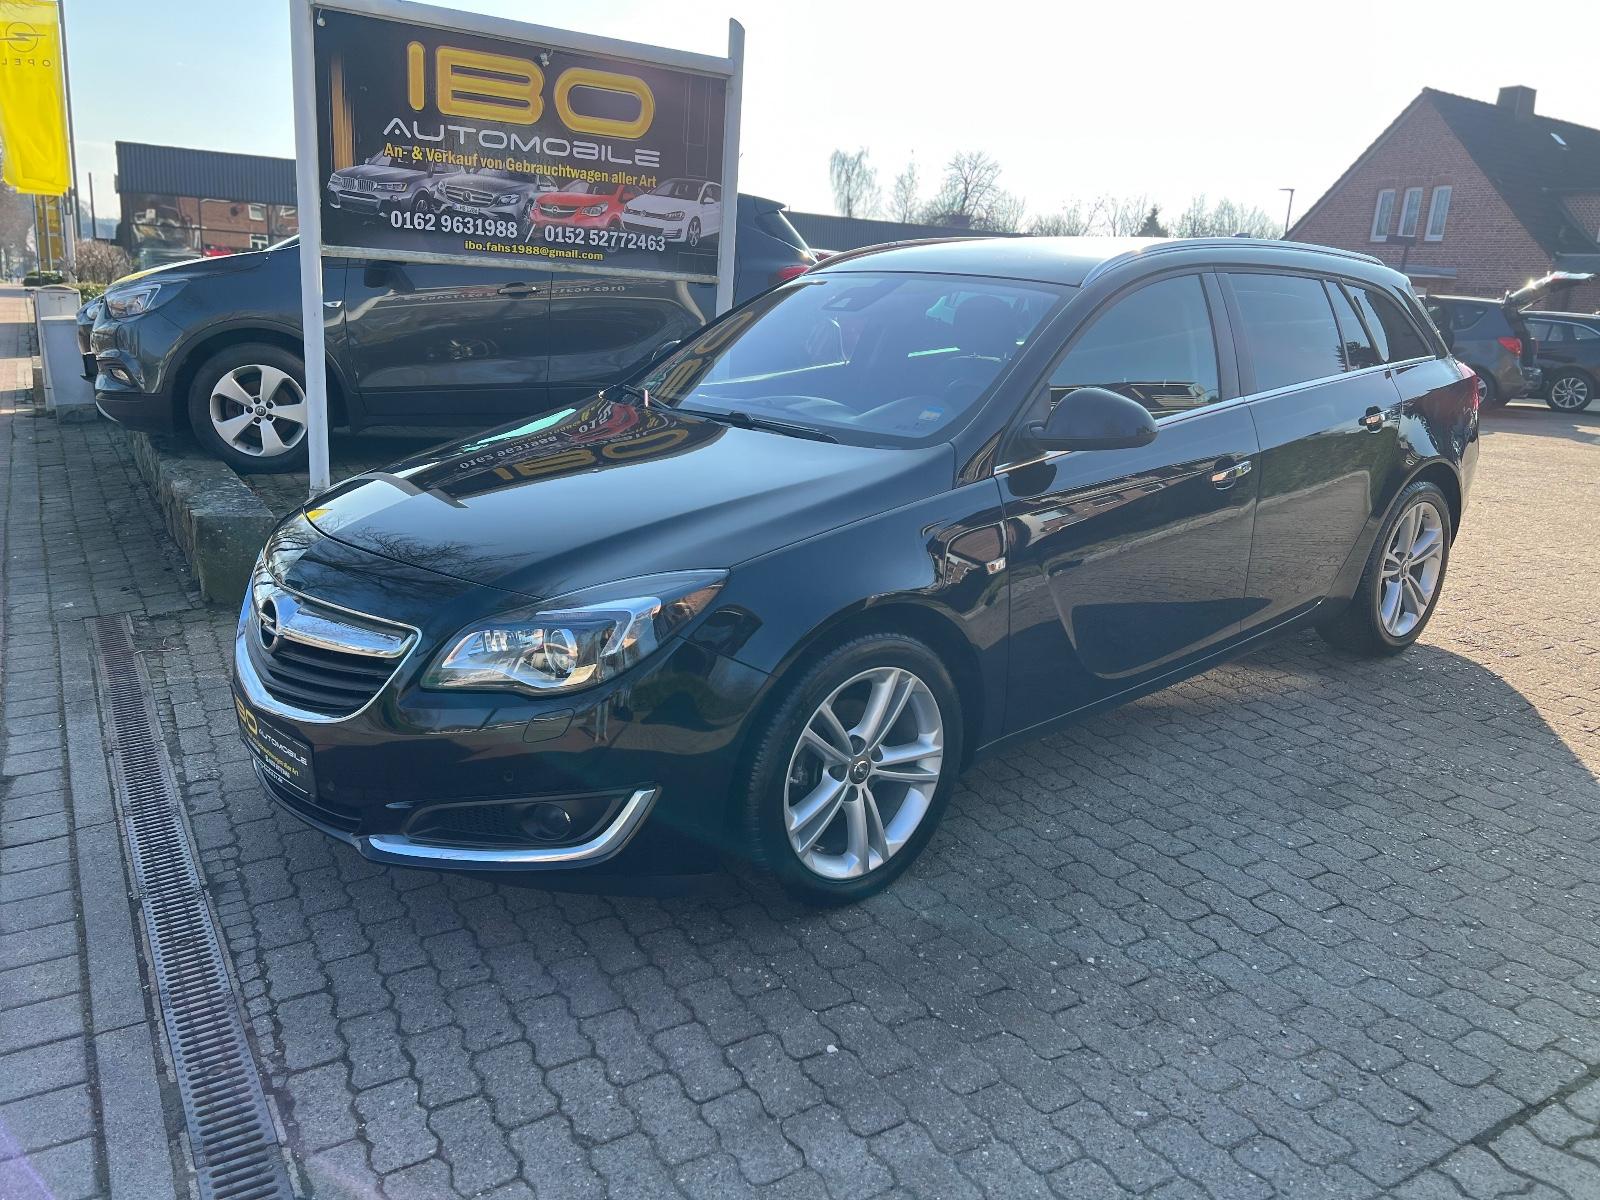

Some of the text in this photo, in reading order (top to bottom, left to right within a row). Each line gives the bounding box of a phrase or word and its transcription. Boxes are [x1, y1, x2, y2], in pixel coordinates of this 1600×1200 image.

[406, 40, 656, 140] IBO
[383, 117, 661, 168] AUTOMOBILE
[384, 142, 657, 188] An- & Verkauf von Gebrauchtwagen aller Art
[390, 210, 436, 231] 0162
[440, 214, 518, 239] 9631988
[544, 225, 585, 245] 0152
[588, 229, 666, 252] 52772463
[464, 240, 604, 261] ibo.fahs1988@gmail.com
